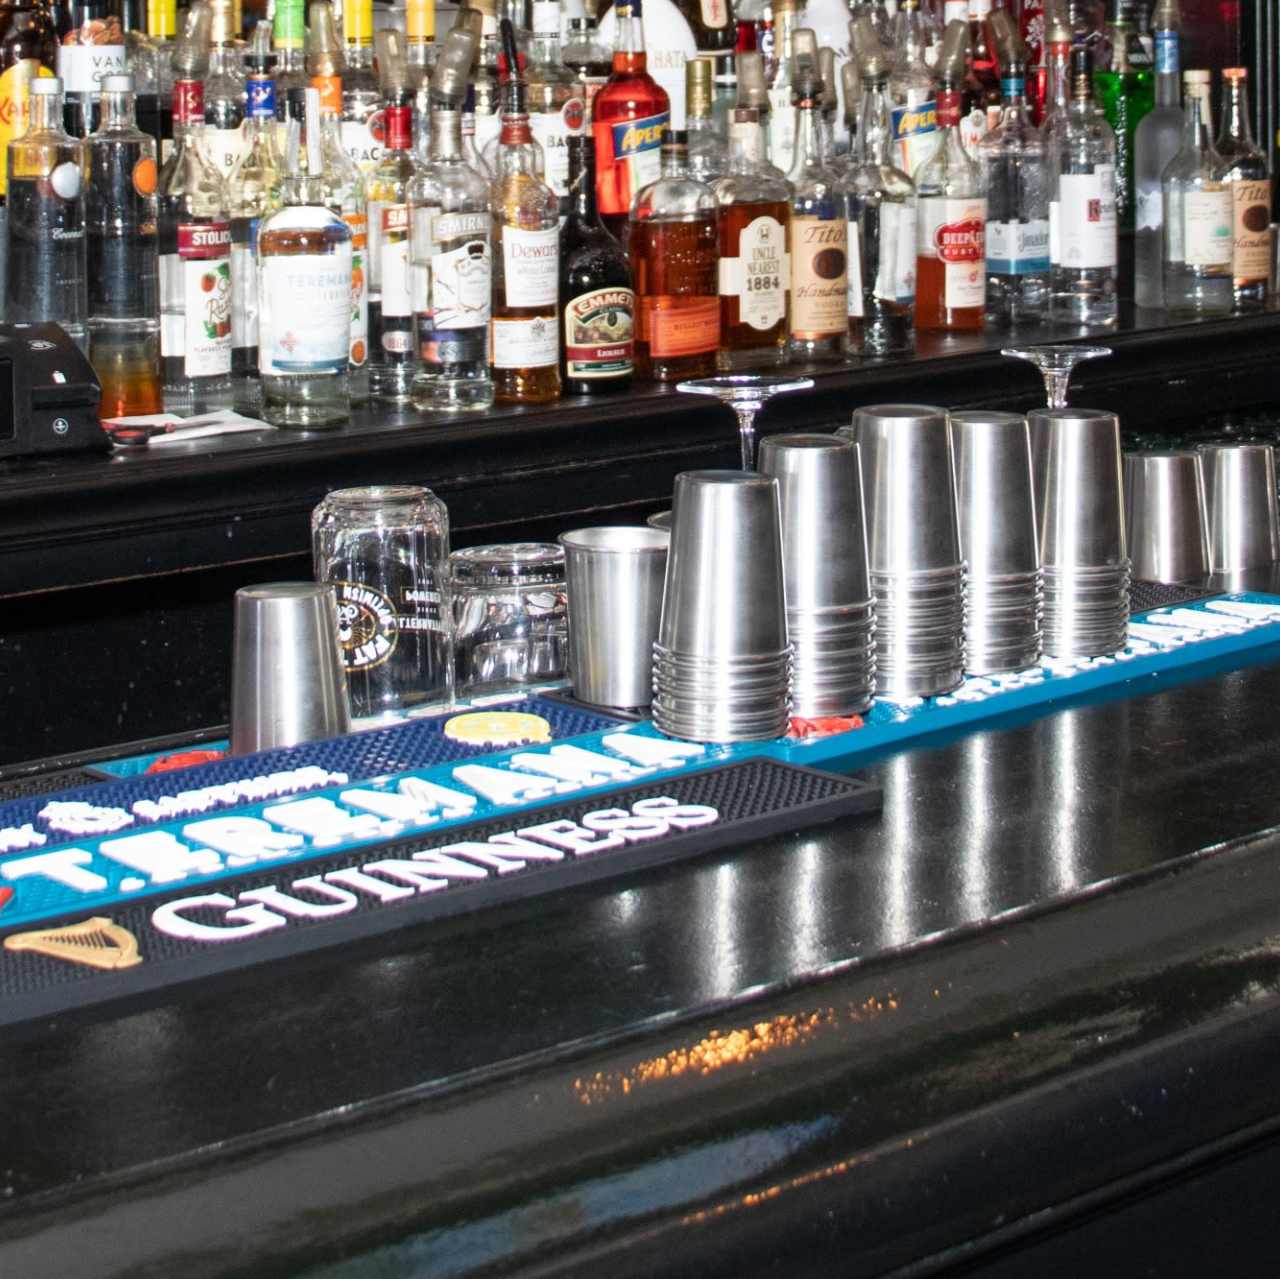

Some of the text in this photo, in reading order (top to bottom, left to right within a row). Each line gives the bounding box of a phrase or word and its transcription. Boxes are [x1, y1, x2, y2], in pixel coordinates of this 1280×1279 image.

[752, 246, 777, 259] UNCLE
[746, 260, 780, 275] NEAREST
[746, 276, 780, 292] 1884
[0, 731, 706, 893] TEREMANA
[151, 795, 720, 942] GUINNESS
